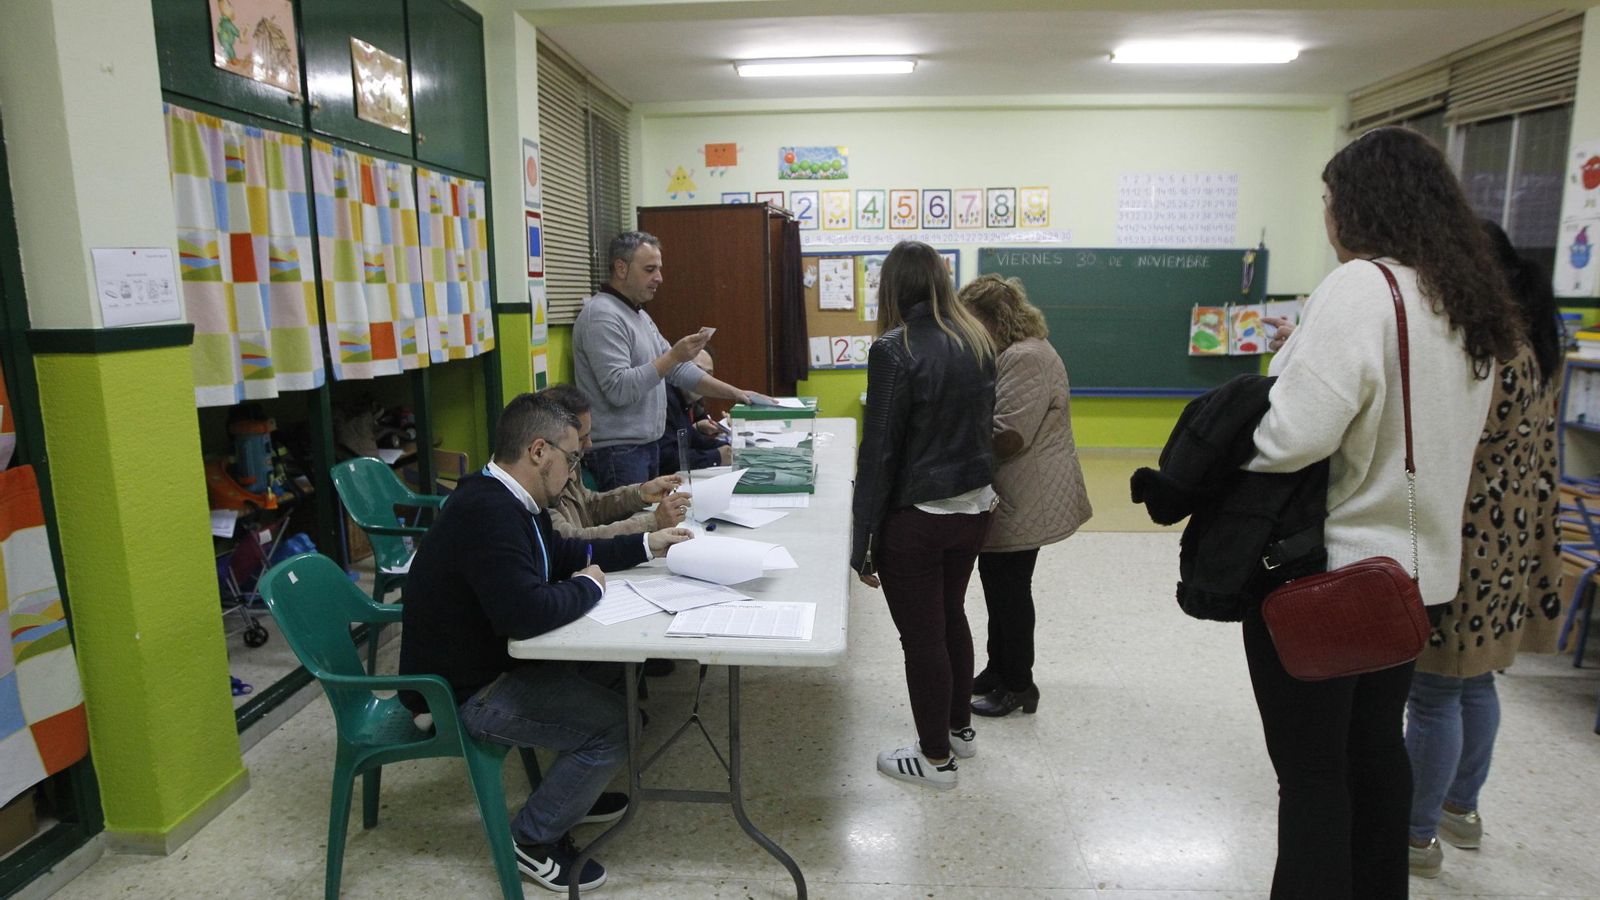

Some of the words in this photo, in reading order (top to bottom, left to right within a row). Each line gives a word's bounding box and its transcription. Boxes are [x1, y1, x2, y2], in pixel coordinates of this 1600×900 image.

[798, 197, 813, 220] 2
[829, 196, 845, 220] 3
[862, 196, 878, 218] 4
[897, 196, 912, 218] 5
[929, 196, 945, 218] 6
[961, 195, 977, 218] 7
[994, 194, 1009, 216] 8
[1028, 194, 1043, 216] 9
[996, 252, 1063, 266] VIERNES
[1076, 252, 1097, 268] 30
[1109, 256, 1123, 267] DE
[1138, 254, 1210, 268] NOVIEMBRE
[834, 338, 850, 362] 2
[854, 339, 868, 362] 3
